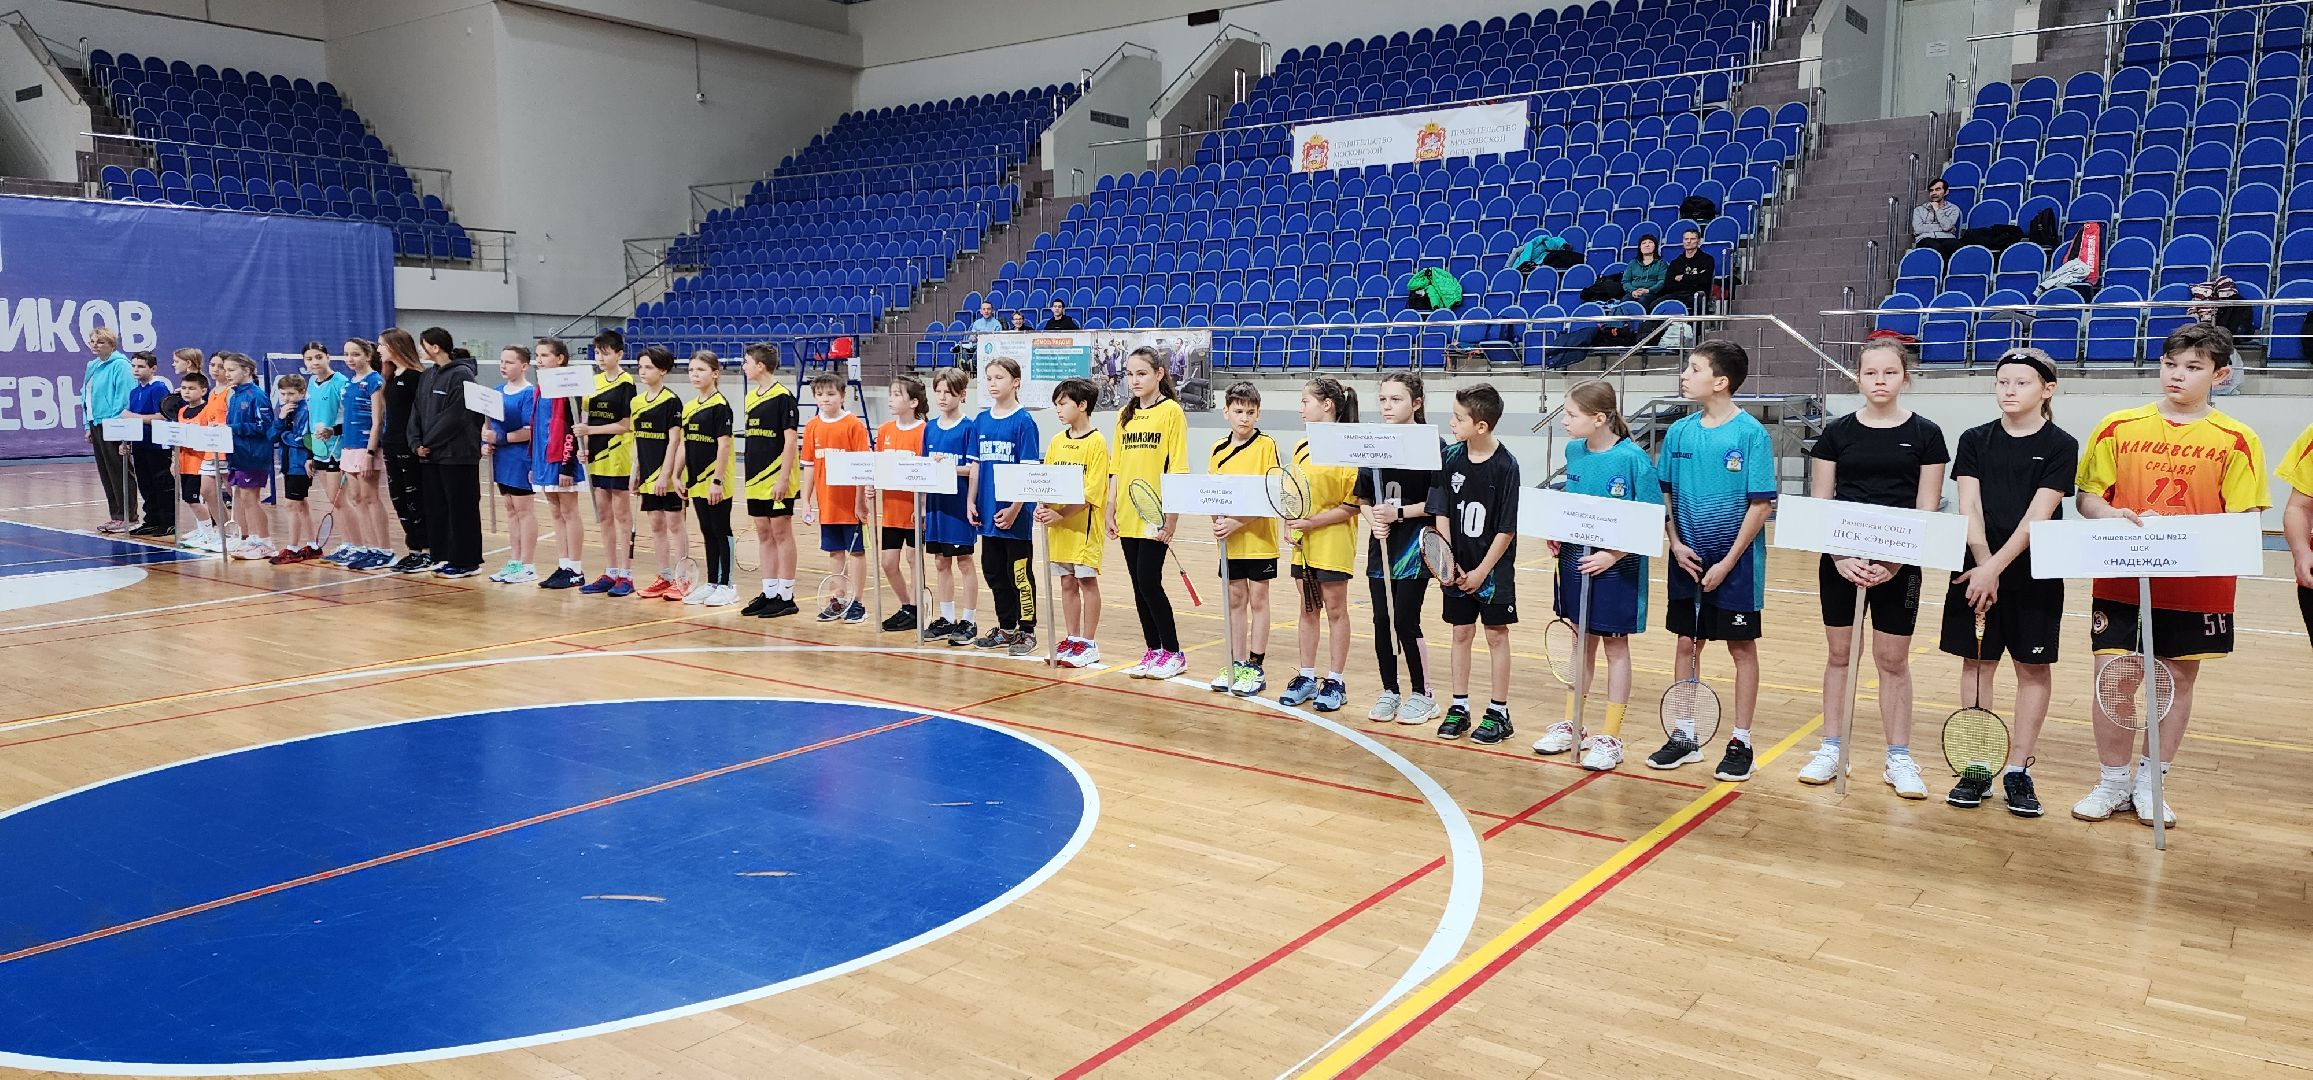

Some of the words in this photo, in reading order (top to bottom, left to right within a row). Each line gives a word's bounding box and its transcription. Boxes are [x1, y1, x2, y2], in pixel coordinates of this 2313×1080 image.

[1451, 124, 1517, 136] ПРАВИТЕЛЬСТВО
[1334, 137, 1393, 149] ПРАВИТЕЛЬСТВО
[1450, 136, 1506, 147] МОСКОВСКОЙ
[1334, 147, 1383, 158] МОСКОВСКОЙ
[1449, 147, 1486, 156] ОБЛАСТИ
[1333, 158, 1365, 168] ОБЛАСТИ
[1122, 432, 1161, 445] ИМНАЗИЯ
[2146, 477, 2189, 507] 12
[1457, 500, 1487, 538] 10
[1841, 518, 1882, 530] Раменская
[1884, 524, 1905, 534] СОШ
[1833, 529, 1861, 541] ШСК
[1864, 534, 1918, 550] «Эверест»
[2092, 533, 2142, 541] Клишевская
[2144, 533, 2165, 541] СОШ
[2166, 533, 2188, 541] №12
[2103, 557, 2178, 567] «НАДЕЖДА»
